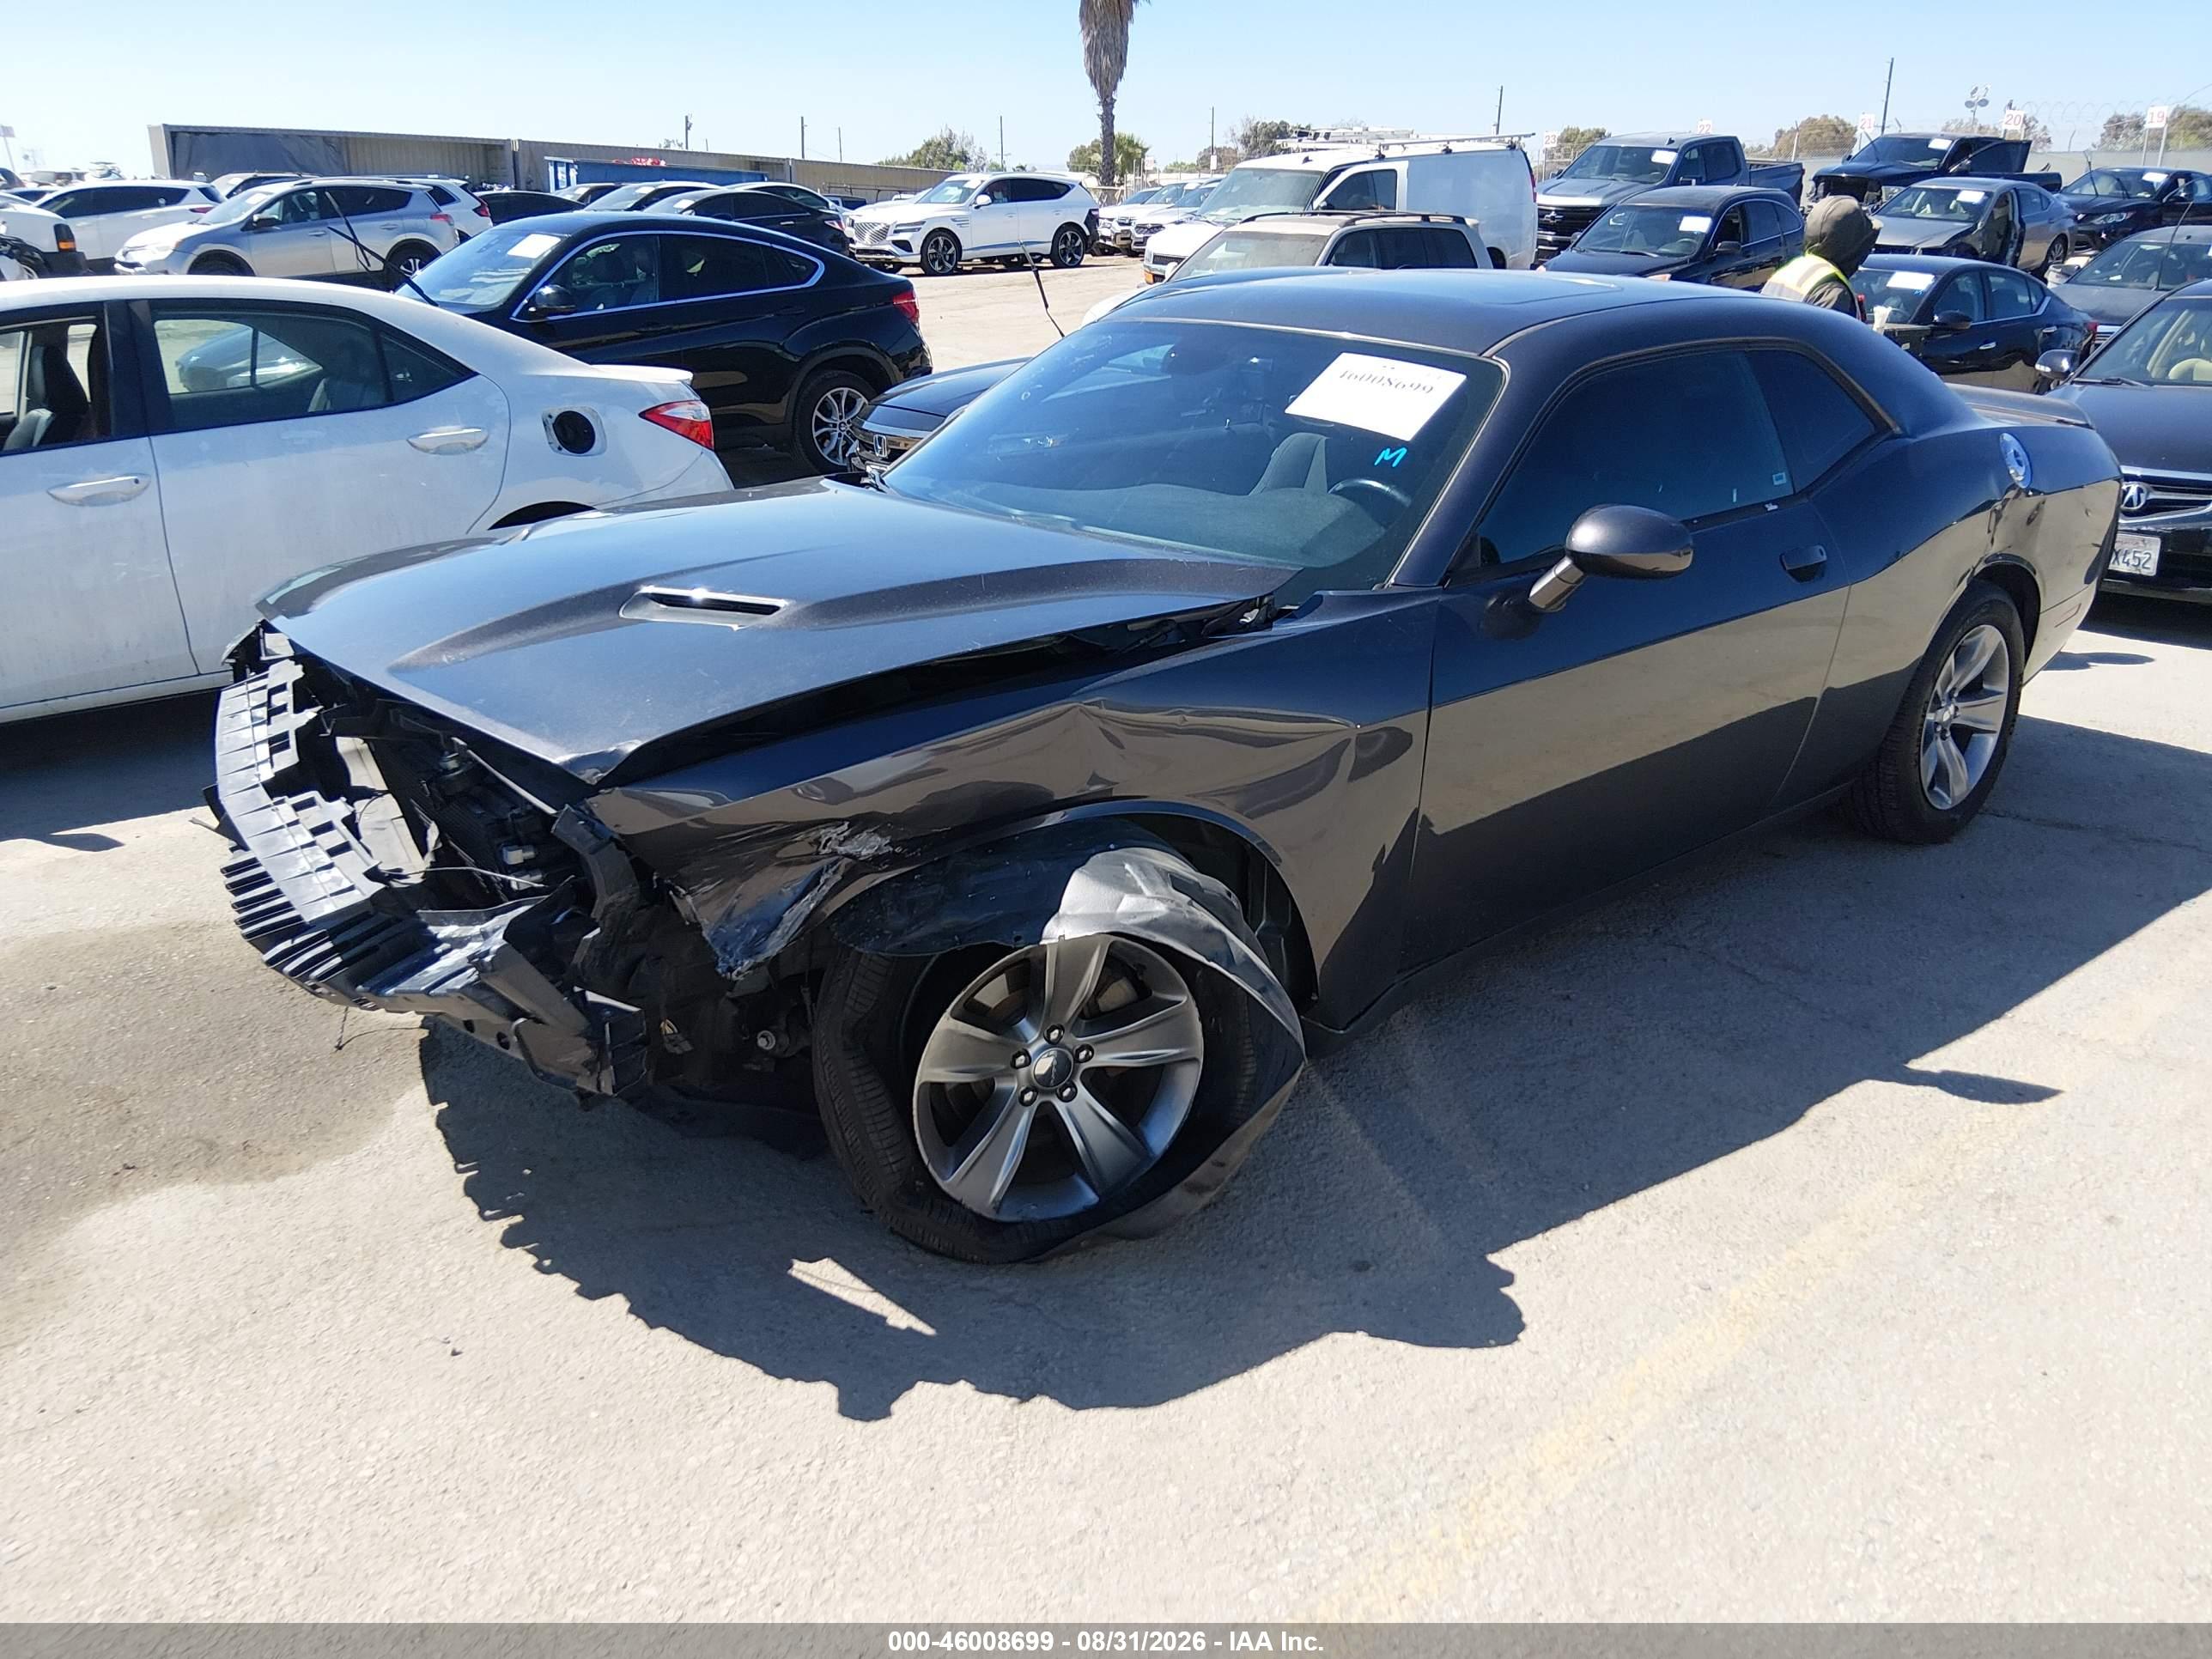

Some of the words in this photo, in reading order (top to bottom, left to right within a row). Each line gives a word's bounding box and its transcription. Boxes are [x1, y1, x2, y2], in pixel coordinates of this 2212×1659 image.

[2005, 113, 2021, 126] 20
[2148, 111, 2165, 124] 19
[1698, 124, 1711, 134] 22
[1860, 118, 1873, 130] 21
[1544, 134, 1557, 145] 23
[1374, 447, 1407, 468] M
